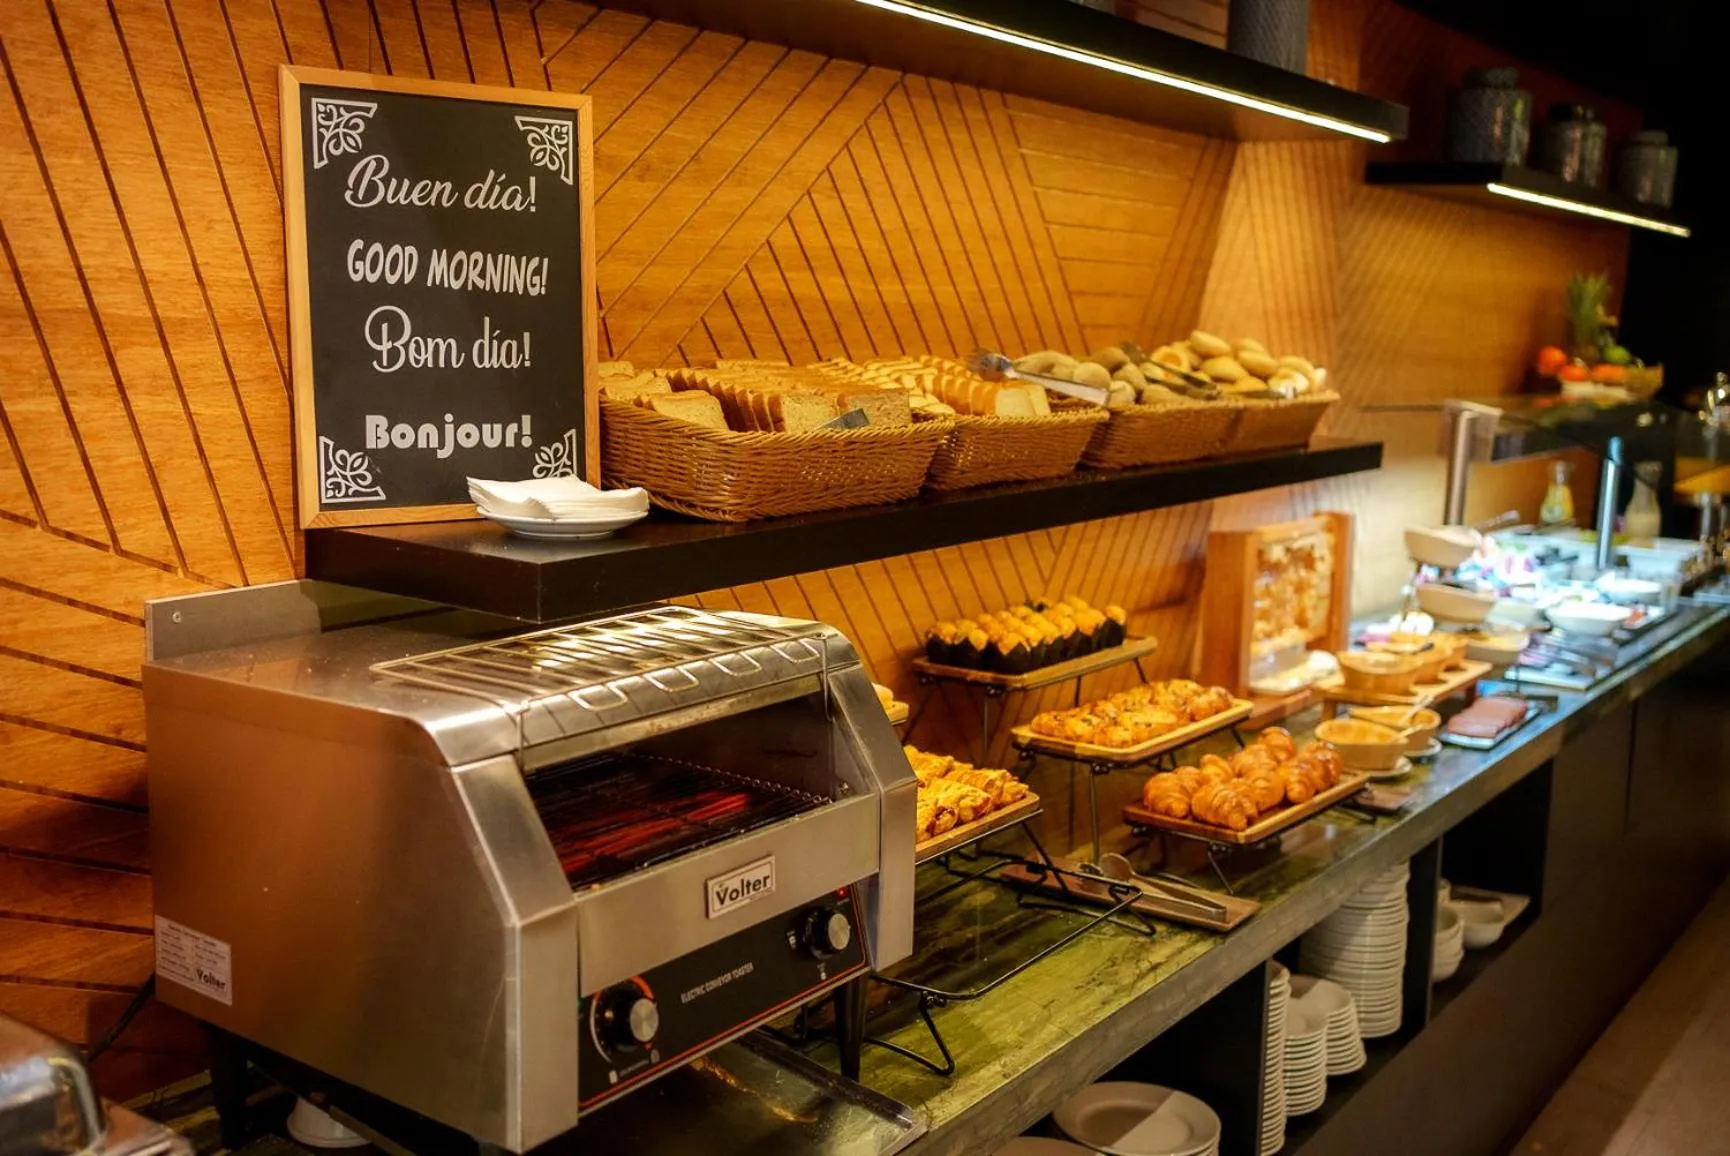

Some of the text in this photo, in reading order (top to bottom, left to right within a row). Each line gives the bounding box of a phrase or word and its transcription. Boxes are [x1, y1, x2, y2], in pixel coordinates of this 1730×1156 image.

[344, 153, 537, 213] Buen día!
[347, 238, 549, 297] GOOD MORNING!
[364, 305, 531, 373] Bom día!
[365, 414, 533, 459] Bonjour!
[715, 874, 770, 905] Volter
